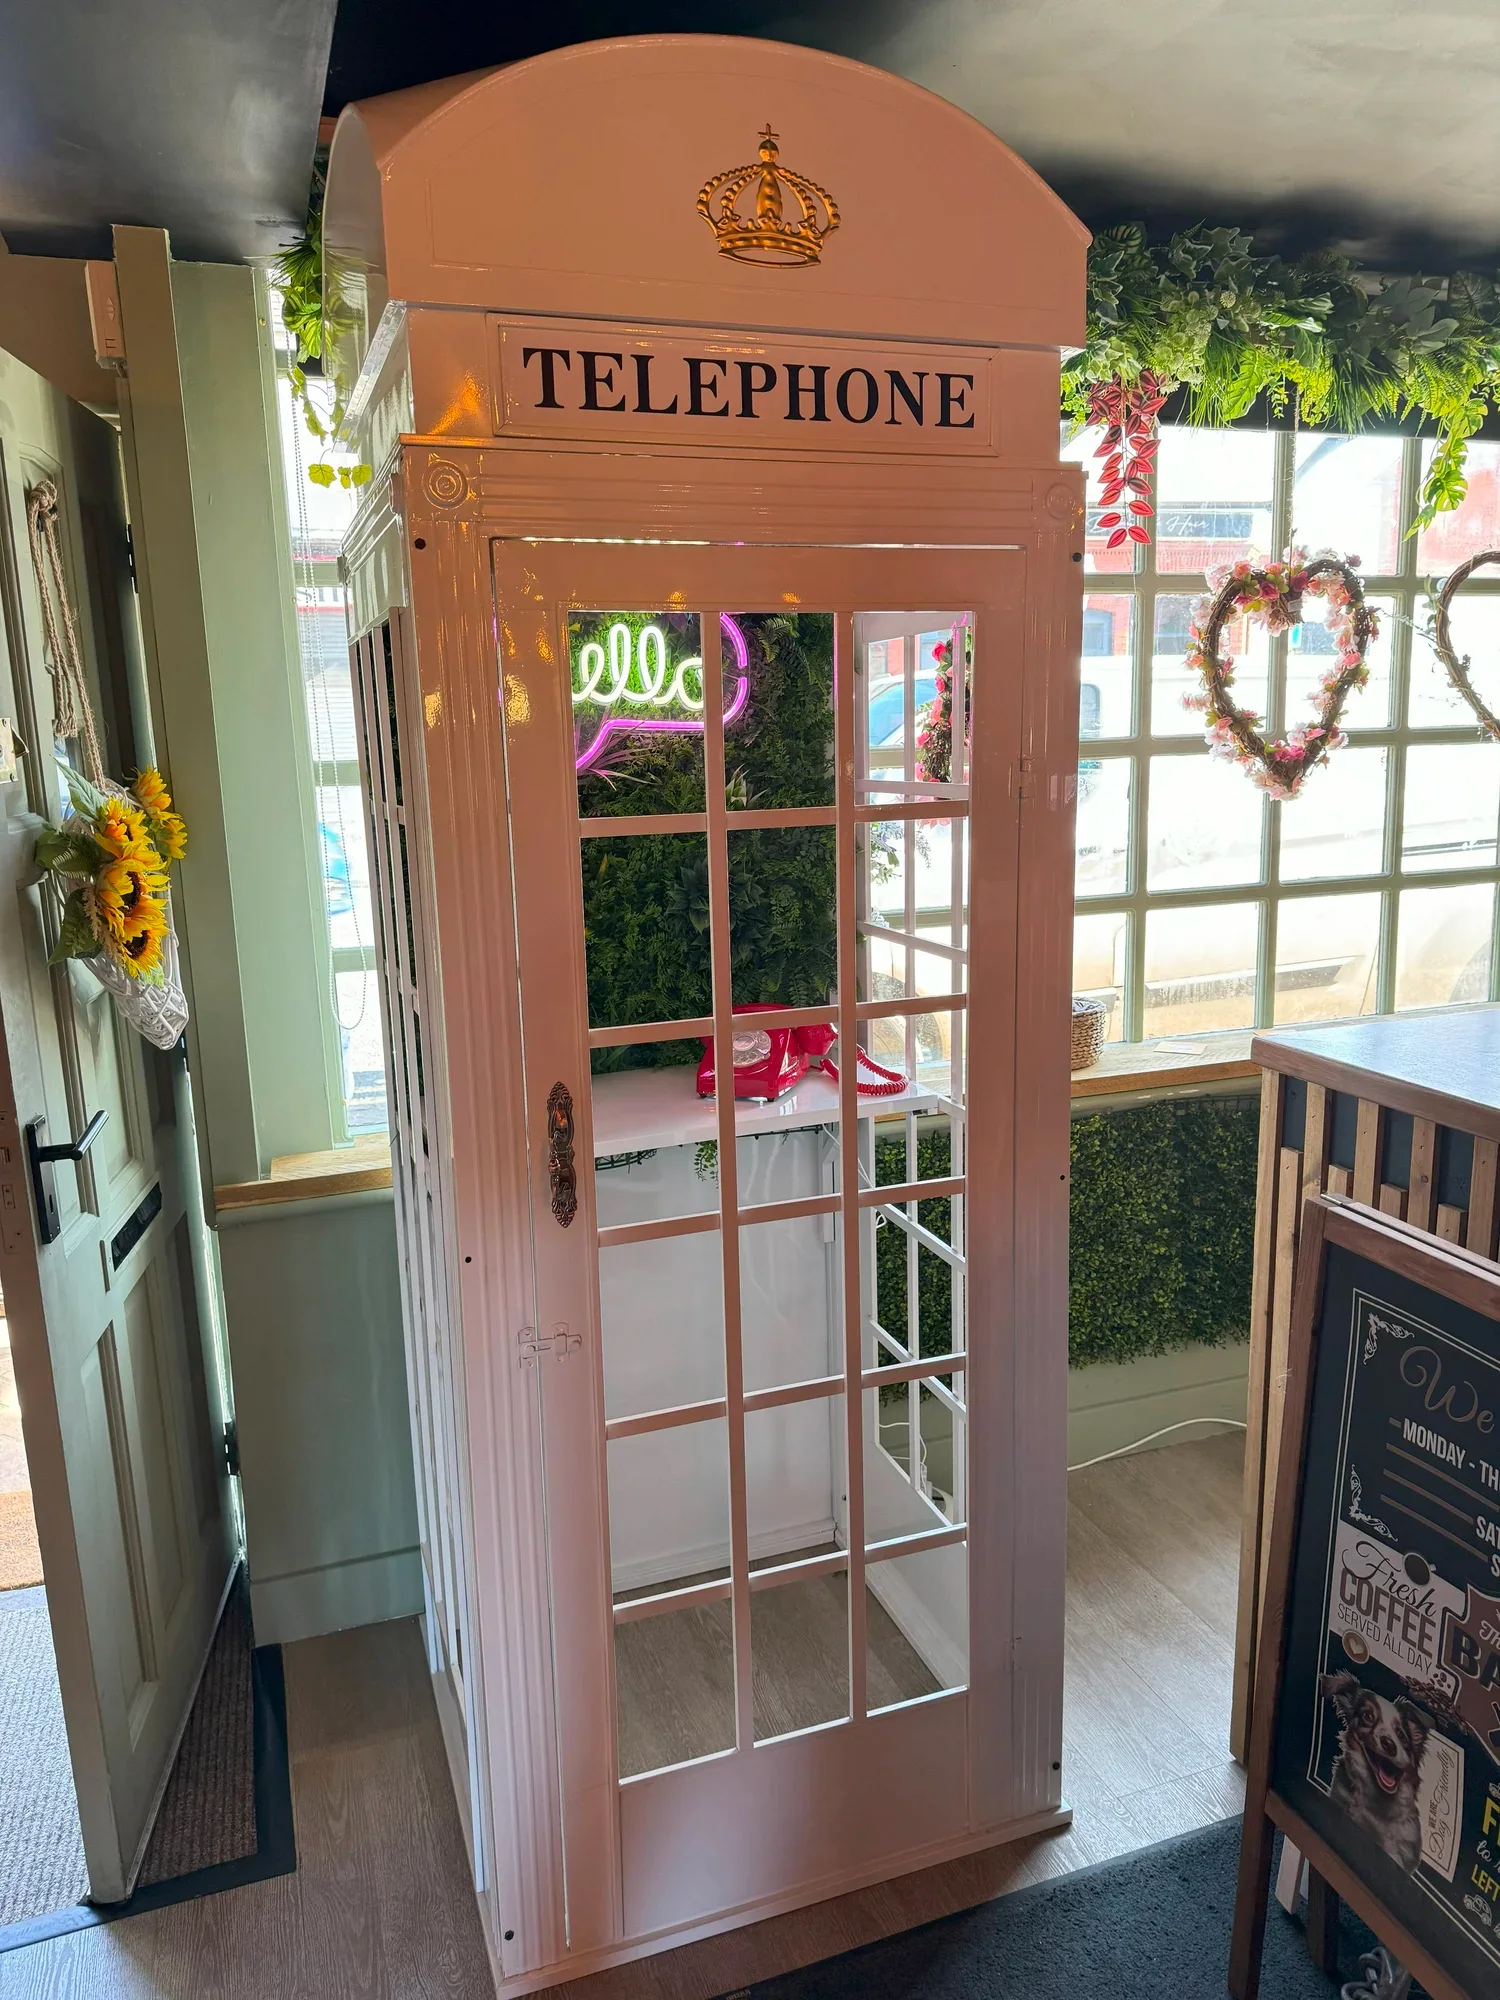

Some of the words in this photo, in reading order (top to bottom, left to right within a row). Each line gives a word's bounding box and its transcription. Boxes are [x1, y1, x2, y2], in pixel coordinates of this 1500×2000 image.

[522, 346, 976, 428] TELEPHONE
[1402, 1417, 1467, 1469] MONDAY
[1479, 1459, 1500, 1491] TH
[1341, 1540, 1437, 1617] Fresh
[1337, 1603, 1381, 1642] SERVED
[1382, 1633, 1404, 1660] ALL
[1407, 1646, 1433, 1676] DAY
[1339, 1567, 1437, 1659] COFFEE
[1428, 1799, 1438, 1816] ARE
[1433, 1748, 1455, 1816] Friendly
[1428, 1815, 1437, 1829] WE
[1428, 1818, 1452, 1860] Dog
[1476, 1840, 1493, 1863] to
[1471, 1863, 1500, 1902] LEFT
